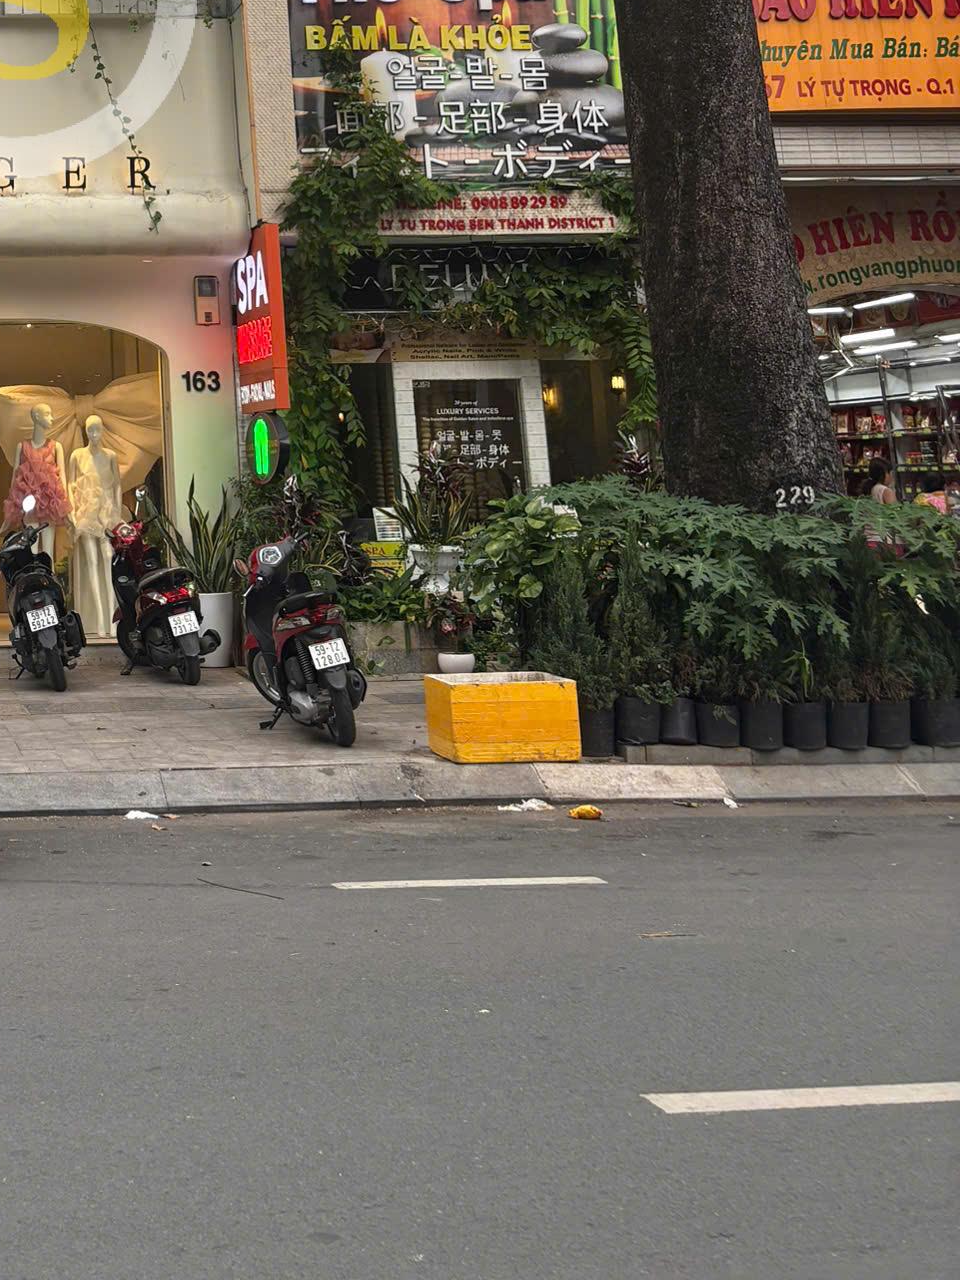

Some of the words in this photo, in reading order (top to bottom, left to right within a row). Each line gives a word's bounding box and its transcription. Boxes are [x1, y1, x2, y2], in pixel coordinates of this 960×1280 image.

[388, 16, 431, 50] LÀ
[440, 14, 532, 51] KHỎE
[760, 39, 822, 67] huyên
[830, 38, 873, 60] Mua
[798, 76, 816, 98] LÝ
[821, 77, 845, 102] TỰ
[849, 79, 911, 101] TRỌNG
[471, 196, 506, 210] 0908
[511, 196, 528, 210] 89
[530, 195, 547, 209] 29
[550, 195, 568, 209] 89
[419, 218, 465, 232] TRONG
[497, 218, 545, 231] THANH
[548, 216, 606, 230] DISTRICT
[808, 206, 896, 255] HIÊN
[237, 249, 269, 315] SPA
[181, 371, 221, 393] 163
[436, 407, 463, 415] LUXURY
[465, 407, 499, 415] SERVICES
[775, 485, 815, 508] 229
